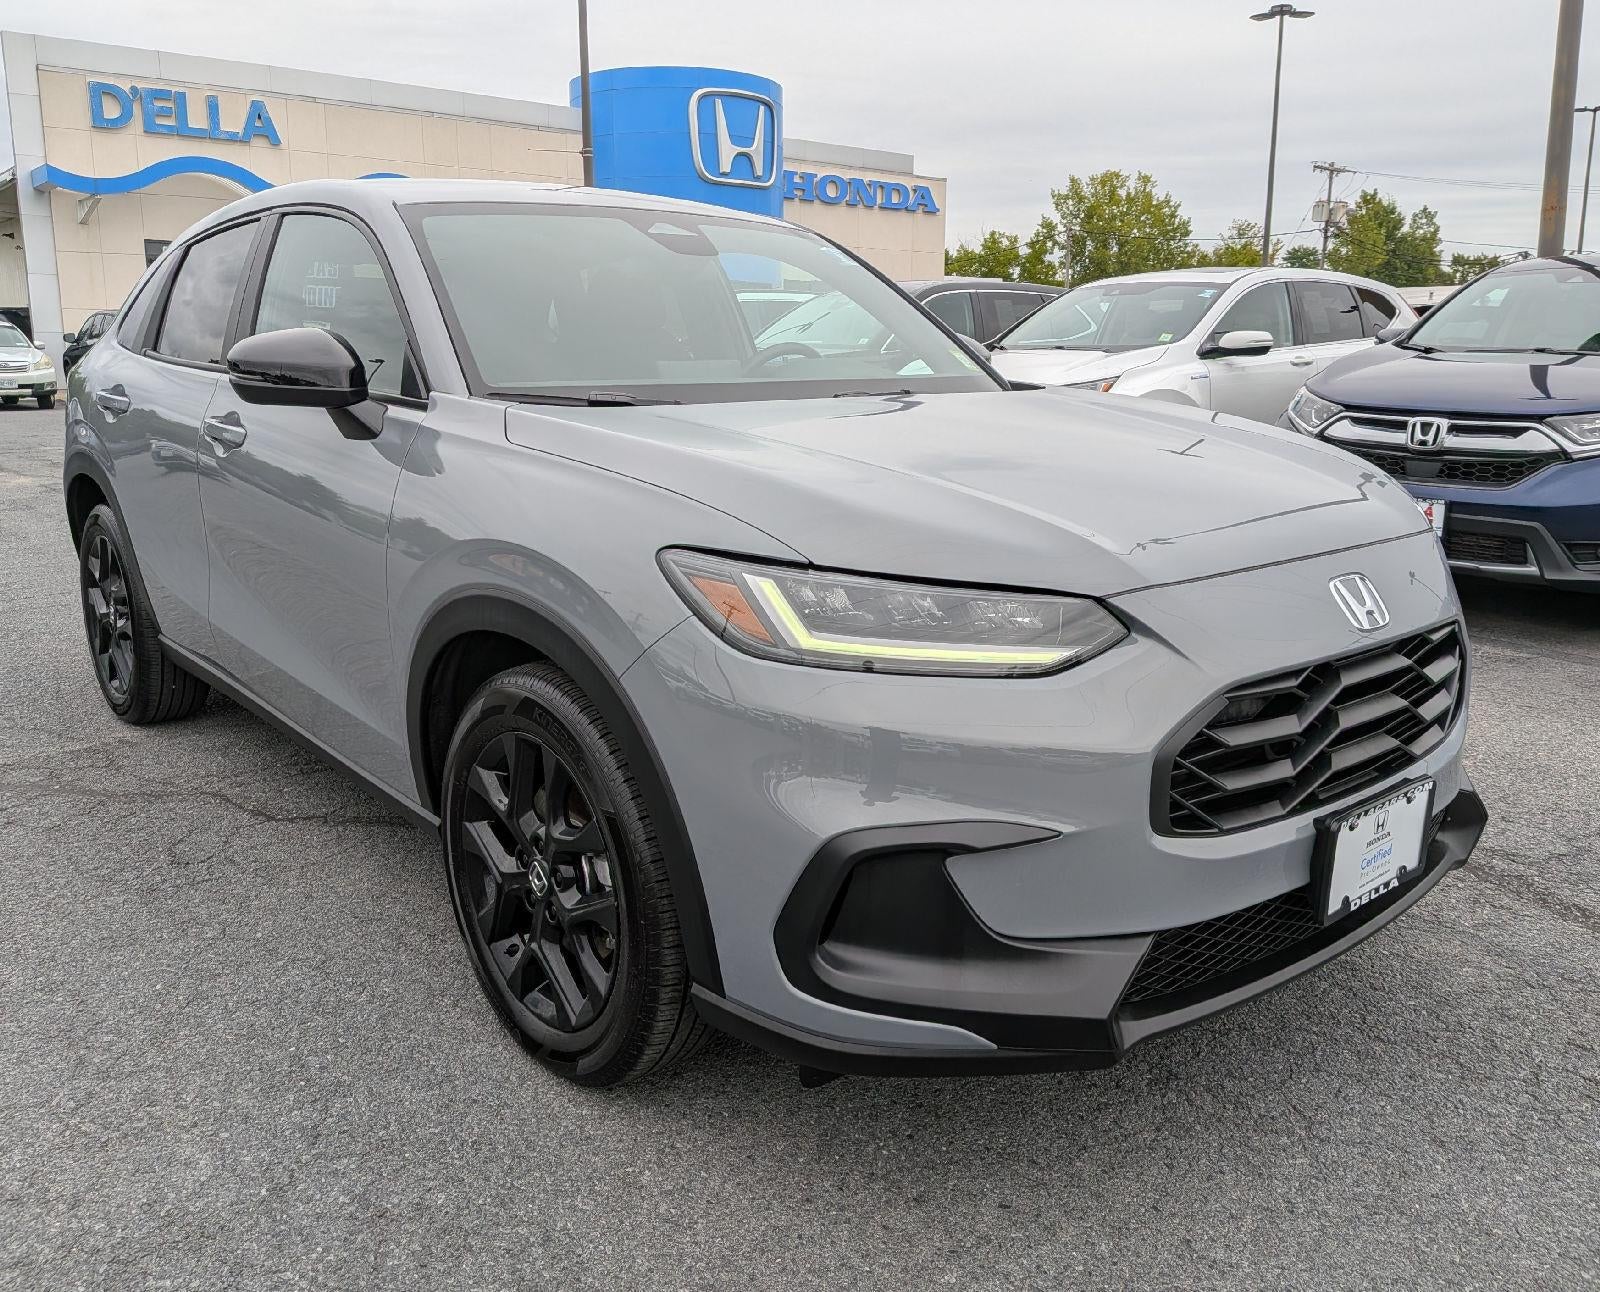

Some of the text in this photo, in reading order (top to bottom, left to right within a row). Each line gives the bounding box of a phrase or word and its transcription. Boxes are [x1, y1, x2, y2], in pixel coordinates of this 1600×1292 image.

[88, 80, 282, 146] D'ELLA
[783, 169, 940, 214] HONDA
[1360, 843, 1393, 871] Certified
[1366, 831, 1391, 849] HONDA
[1350, 877, 1399, 912] DELLA
